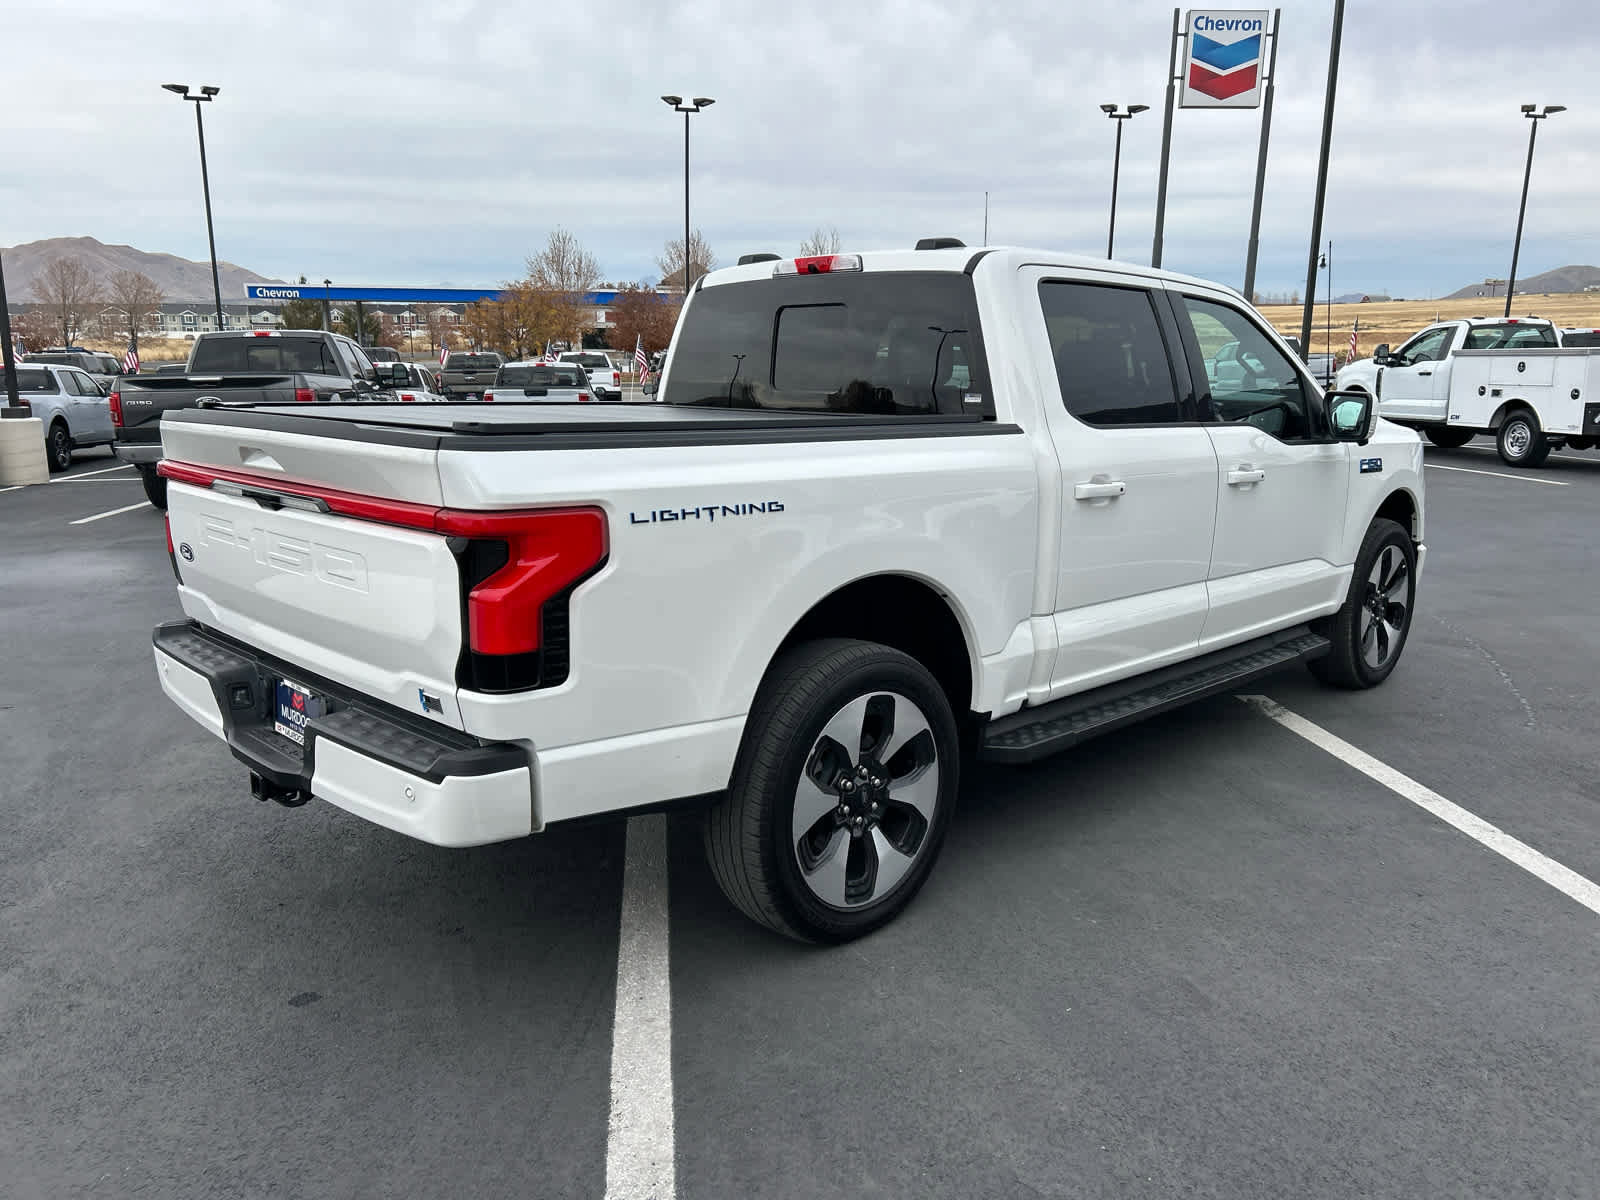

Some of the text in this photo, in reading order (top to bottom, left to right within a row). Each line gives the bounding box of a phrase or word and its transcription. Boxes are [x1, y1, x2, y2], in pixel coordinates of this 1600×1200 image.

[1194, 15, 1262, 31] Chevron
[256, 287, 300, 298] Chevron
[630, 501, 785, 524] LIGHTNING
